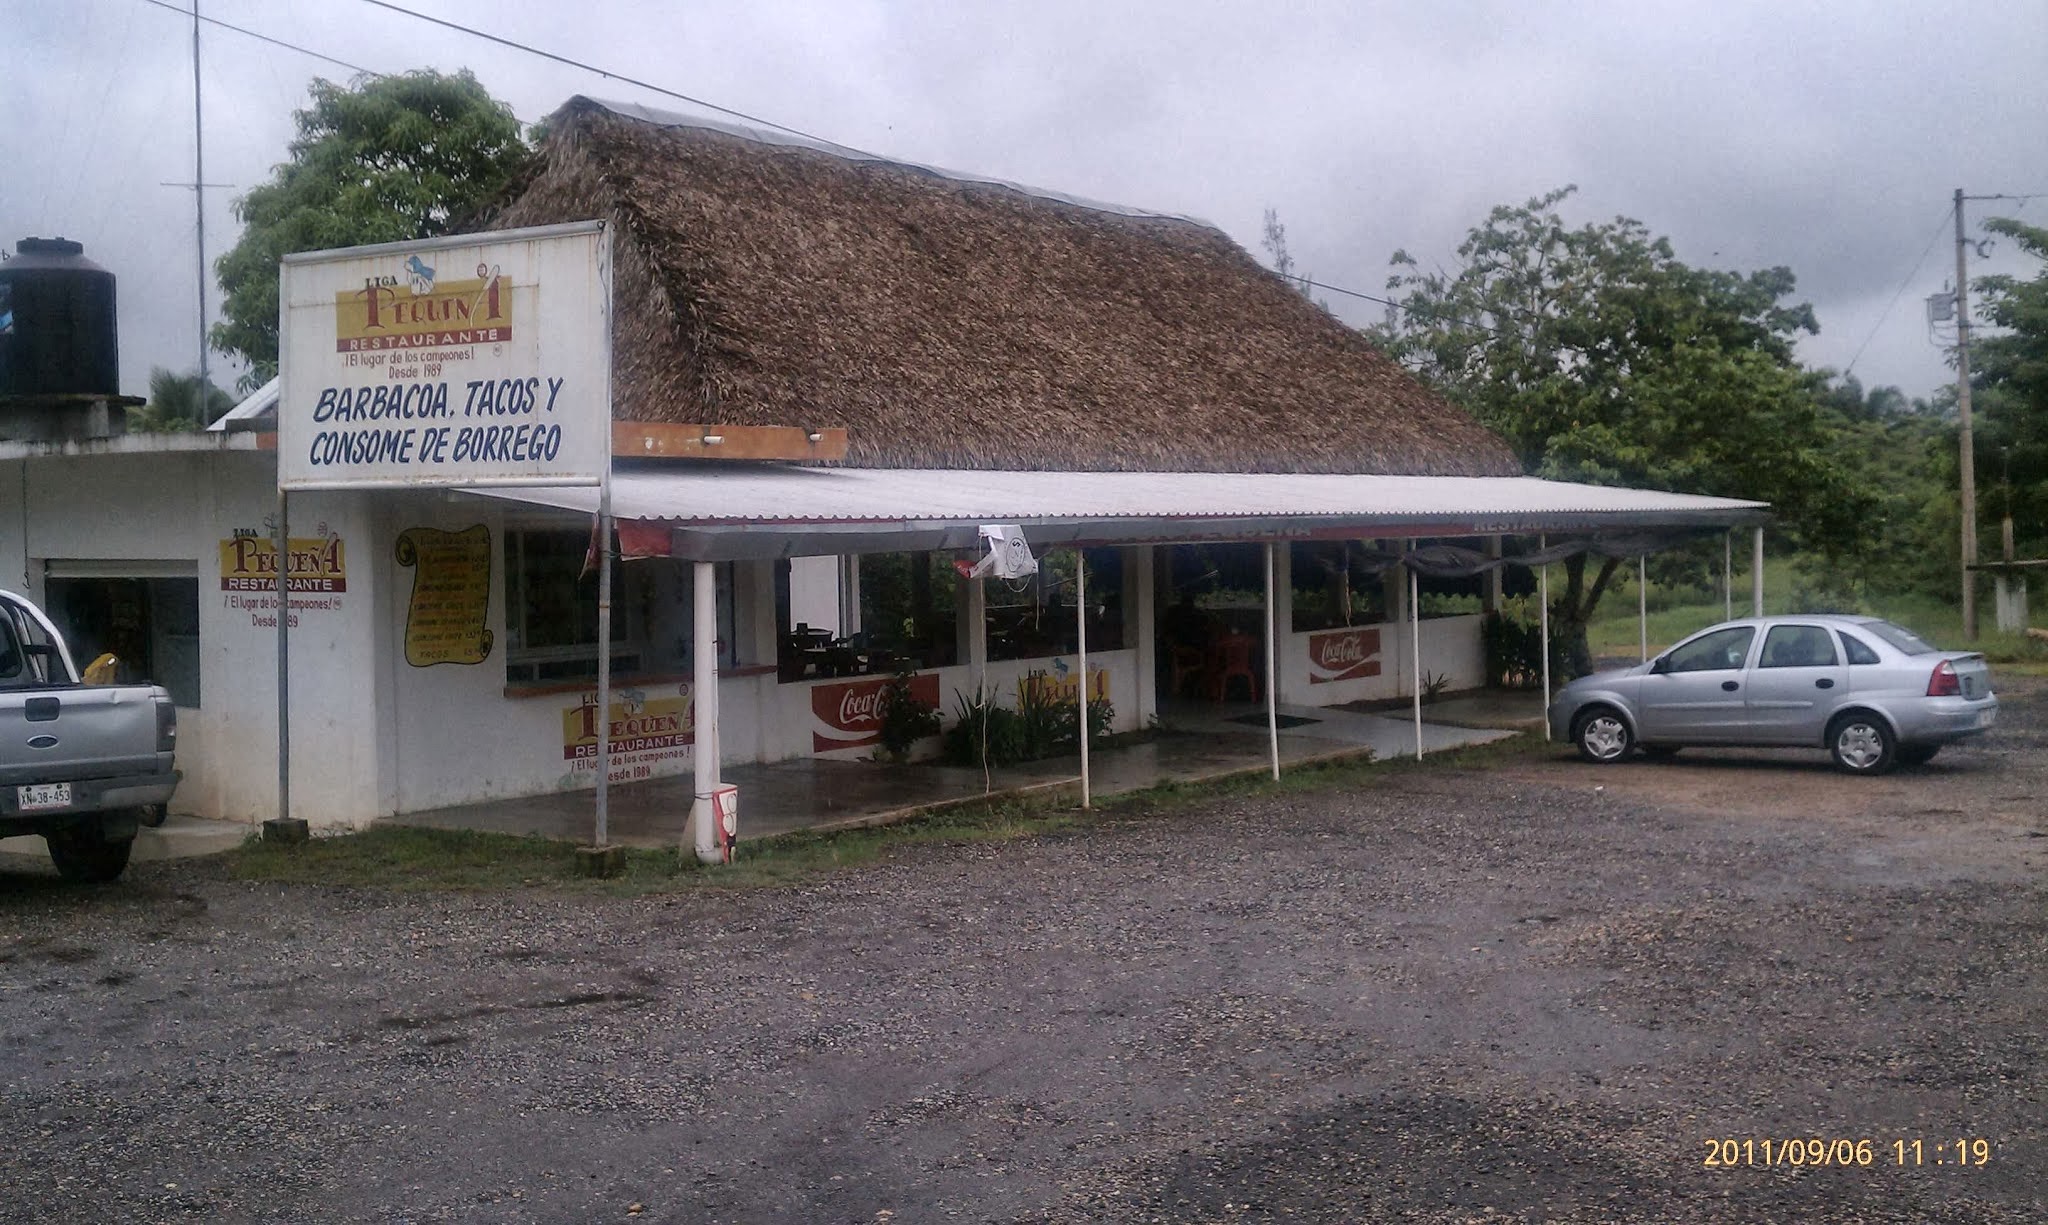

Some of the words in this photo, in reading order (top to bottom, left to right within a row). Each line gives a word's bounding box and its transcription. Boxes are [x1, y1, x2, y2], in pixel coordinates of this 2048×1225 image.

[365, 275, 398, 288] LIGA
[350, 328, 498, 350] RESTAURANTE
[361, 353, 385, 369] lugar
[390, 352, 402, 364] de
[405, 351, 418, 362] los
[388, 364, 418, 379] Desde
[423, 363, 442, 377] 1989
[463, 376, 539, 417] TACOS
[545, 376, 564, 413] Y
[309, 426, 416, 466] CONSOME
[418, 426, 450, 463] DE
[452, 423, 562, 463] BORREGO
[228, 578, 333, 591] RESTARANTE
[240, 595, 259, 612] lugar
[260, 596, 269, 608] de
[252, 614, 277, 627] Desde
[576, 734, 685, 758] RETAURANTE
[608, 769, 631, 782] esde
